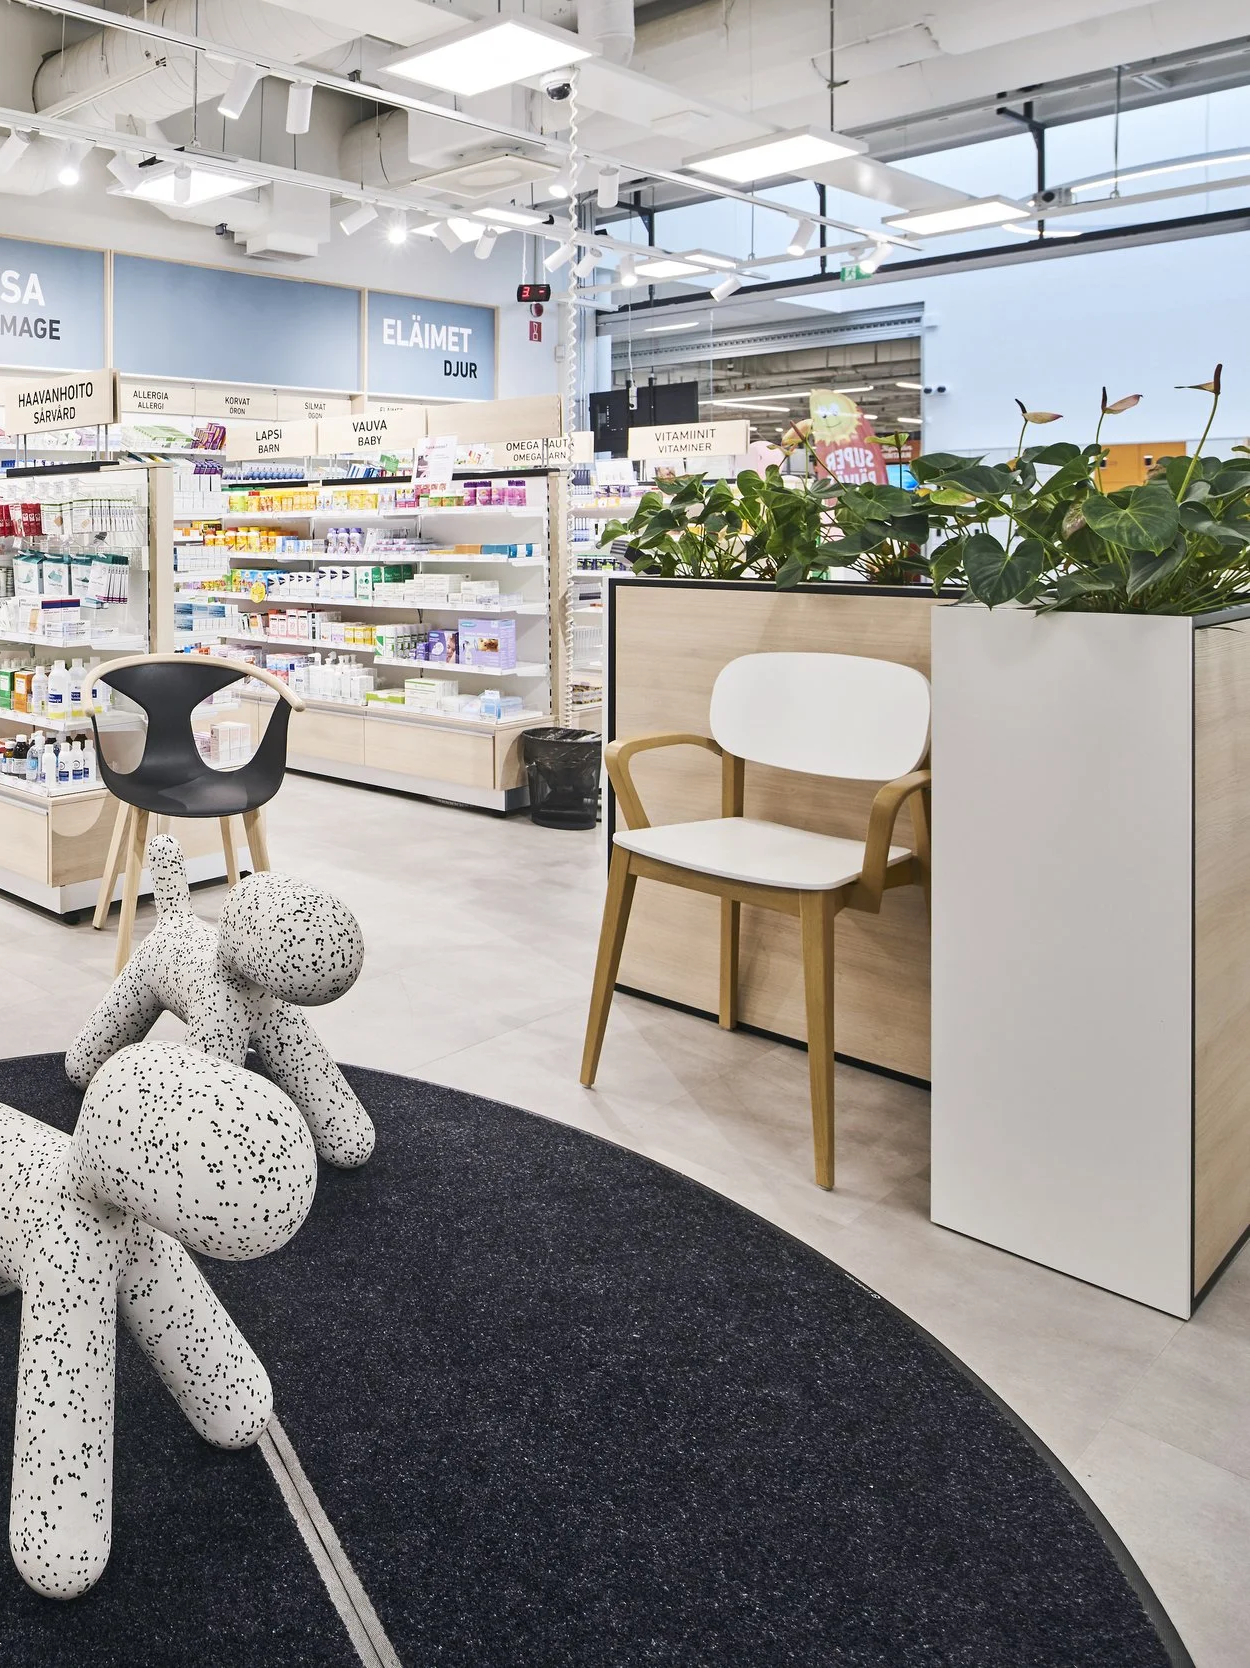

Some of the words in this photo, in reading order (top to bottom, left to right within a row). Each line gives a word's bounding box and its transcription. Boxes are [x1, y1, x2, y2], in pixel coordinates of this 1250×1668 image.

[0, 314, 61, 341] MAGE
[383, 314, 472, 353] ELÄIMET
[443, 360, 478, 379] DJUR
[18, 382, 94, 408] HAAVANHOITO
[132, 390, 169, 400] ALLERGIA
[224, 396, 251, 406] KORVAT
[137, 401, 165, 410] ALLERGI
[33, 404, 77, 425] SÅRVÅRD
[352, 419, 388, 433] VAUVA
[255, 429, 282, 442] LAPSI
[654, 427, 717, 442] VITAMIINIT
[357, 435, 382, 447] BABY
[505, 441, 539, 452] OMEGA
[258, 443, 280, 454] BARN
[658, 442, 712, 454] VITAMINER
[513, 452, 542, 462] OMEGA
